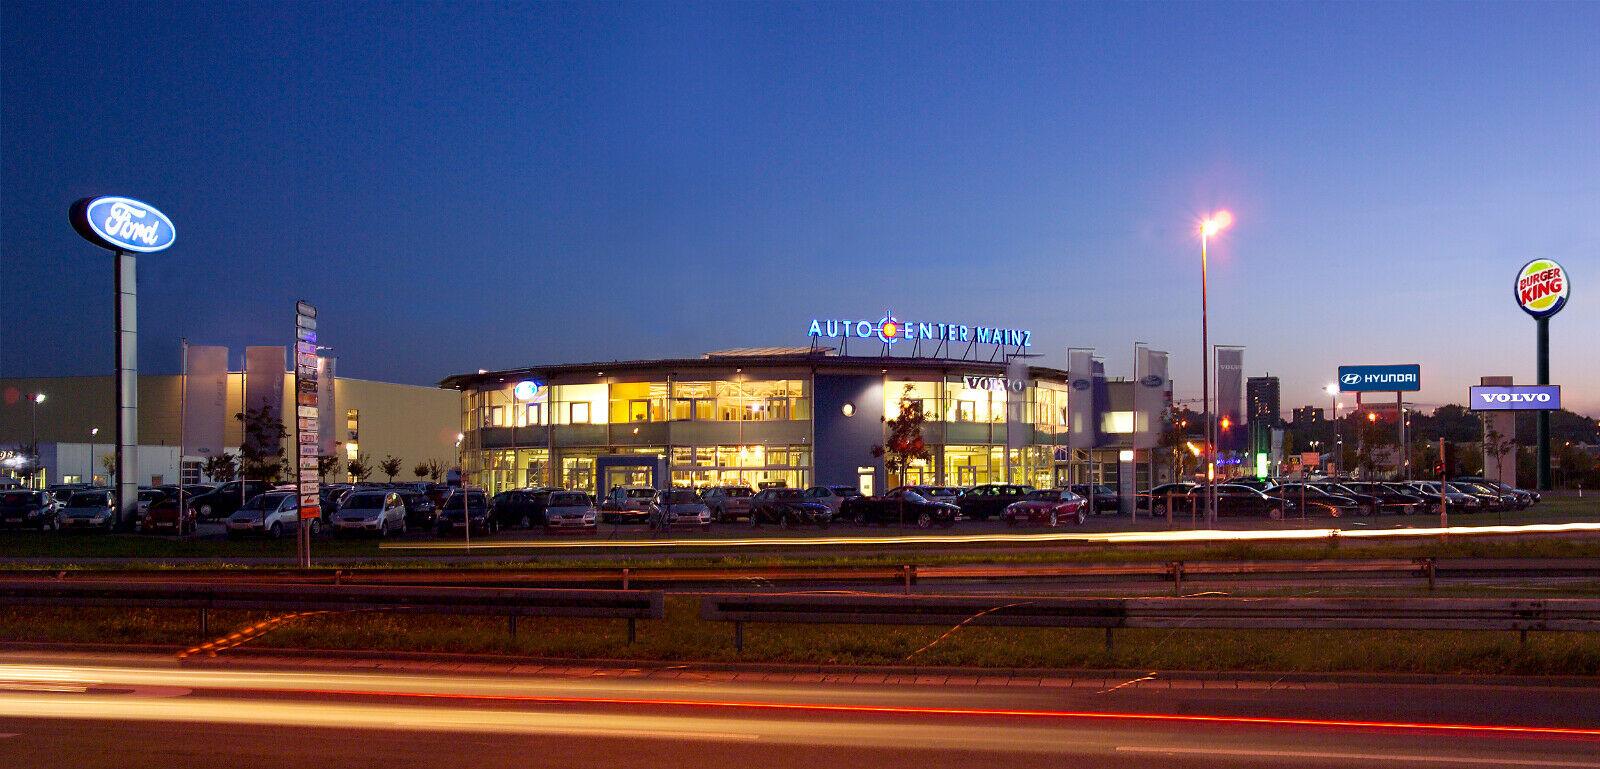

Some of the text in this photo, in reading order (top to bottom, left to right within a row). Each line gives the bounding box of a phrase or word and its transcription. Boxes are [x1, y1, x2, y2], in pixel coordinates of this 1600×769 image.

[105, 202, 159, 245] Ford
[1519, 267, 1561, 291] BURGER
[1521, 278, 1563, 305] KING
[975, 326, 1032, 347] MAINZ
[1364, 373, 1416, 383] HYUNDAI
[1481, 392, 1551, 403] VOLVO
